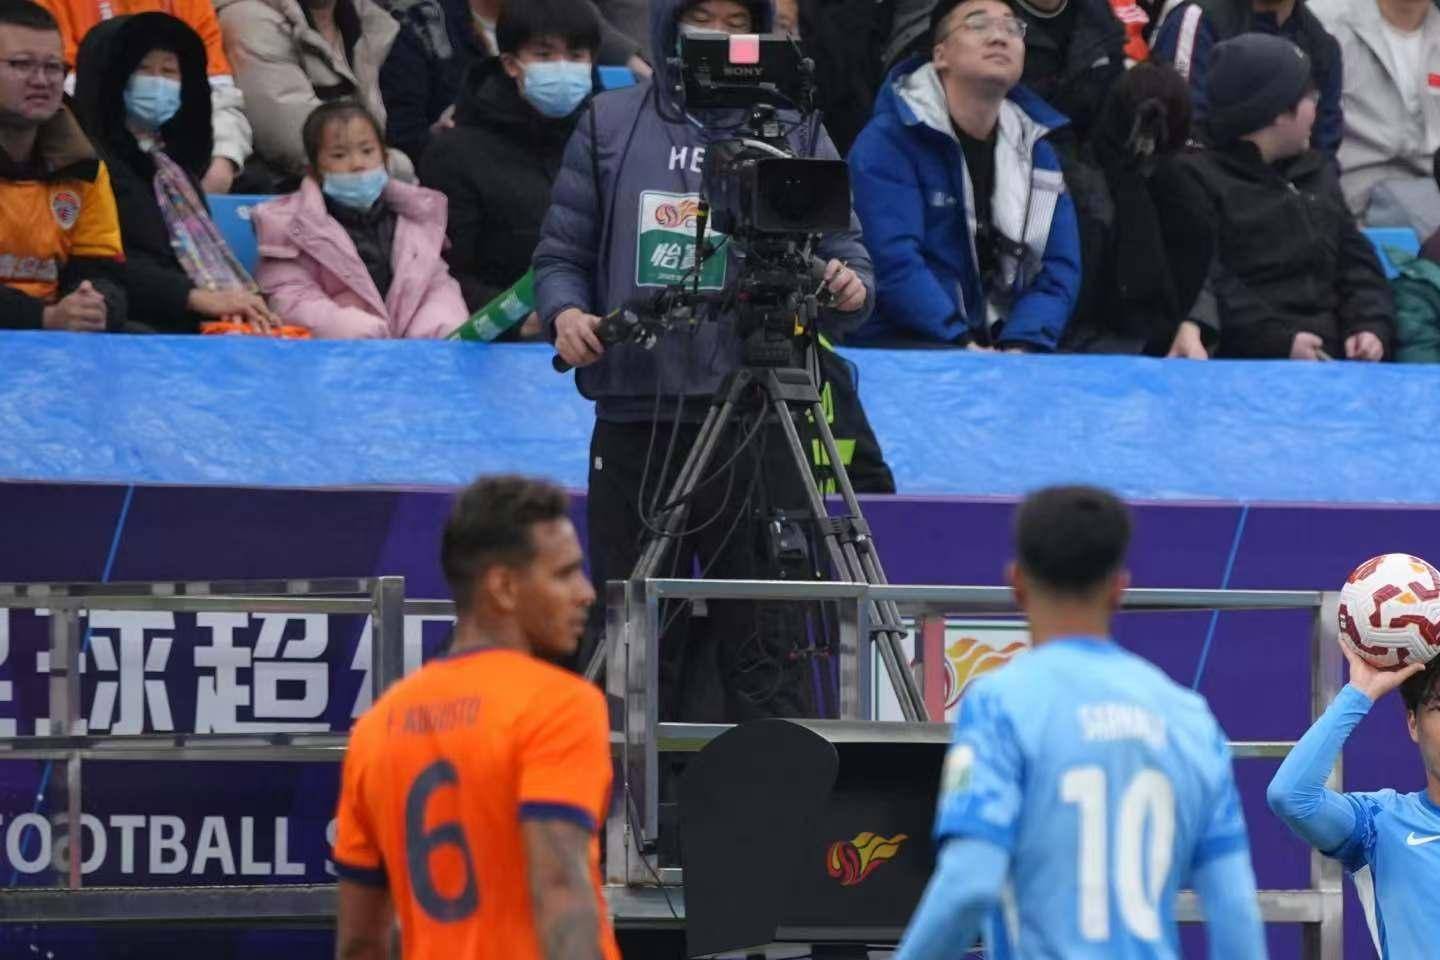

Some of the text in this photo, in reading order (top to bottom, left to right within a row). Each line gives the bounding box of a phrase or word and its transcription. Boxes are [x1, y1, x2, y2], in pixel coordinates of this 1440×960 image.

[0, 607, 456, 735] 球超
[0, 812, 305, 876] OOTBALL
[405, 758, 481, 924] 6
[1061, 767, 1175, 943] 10
